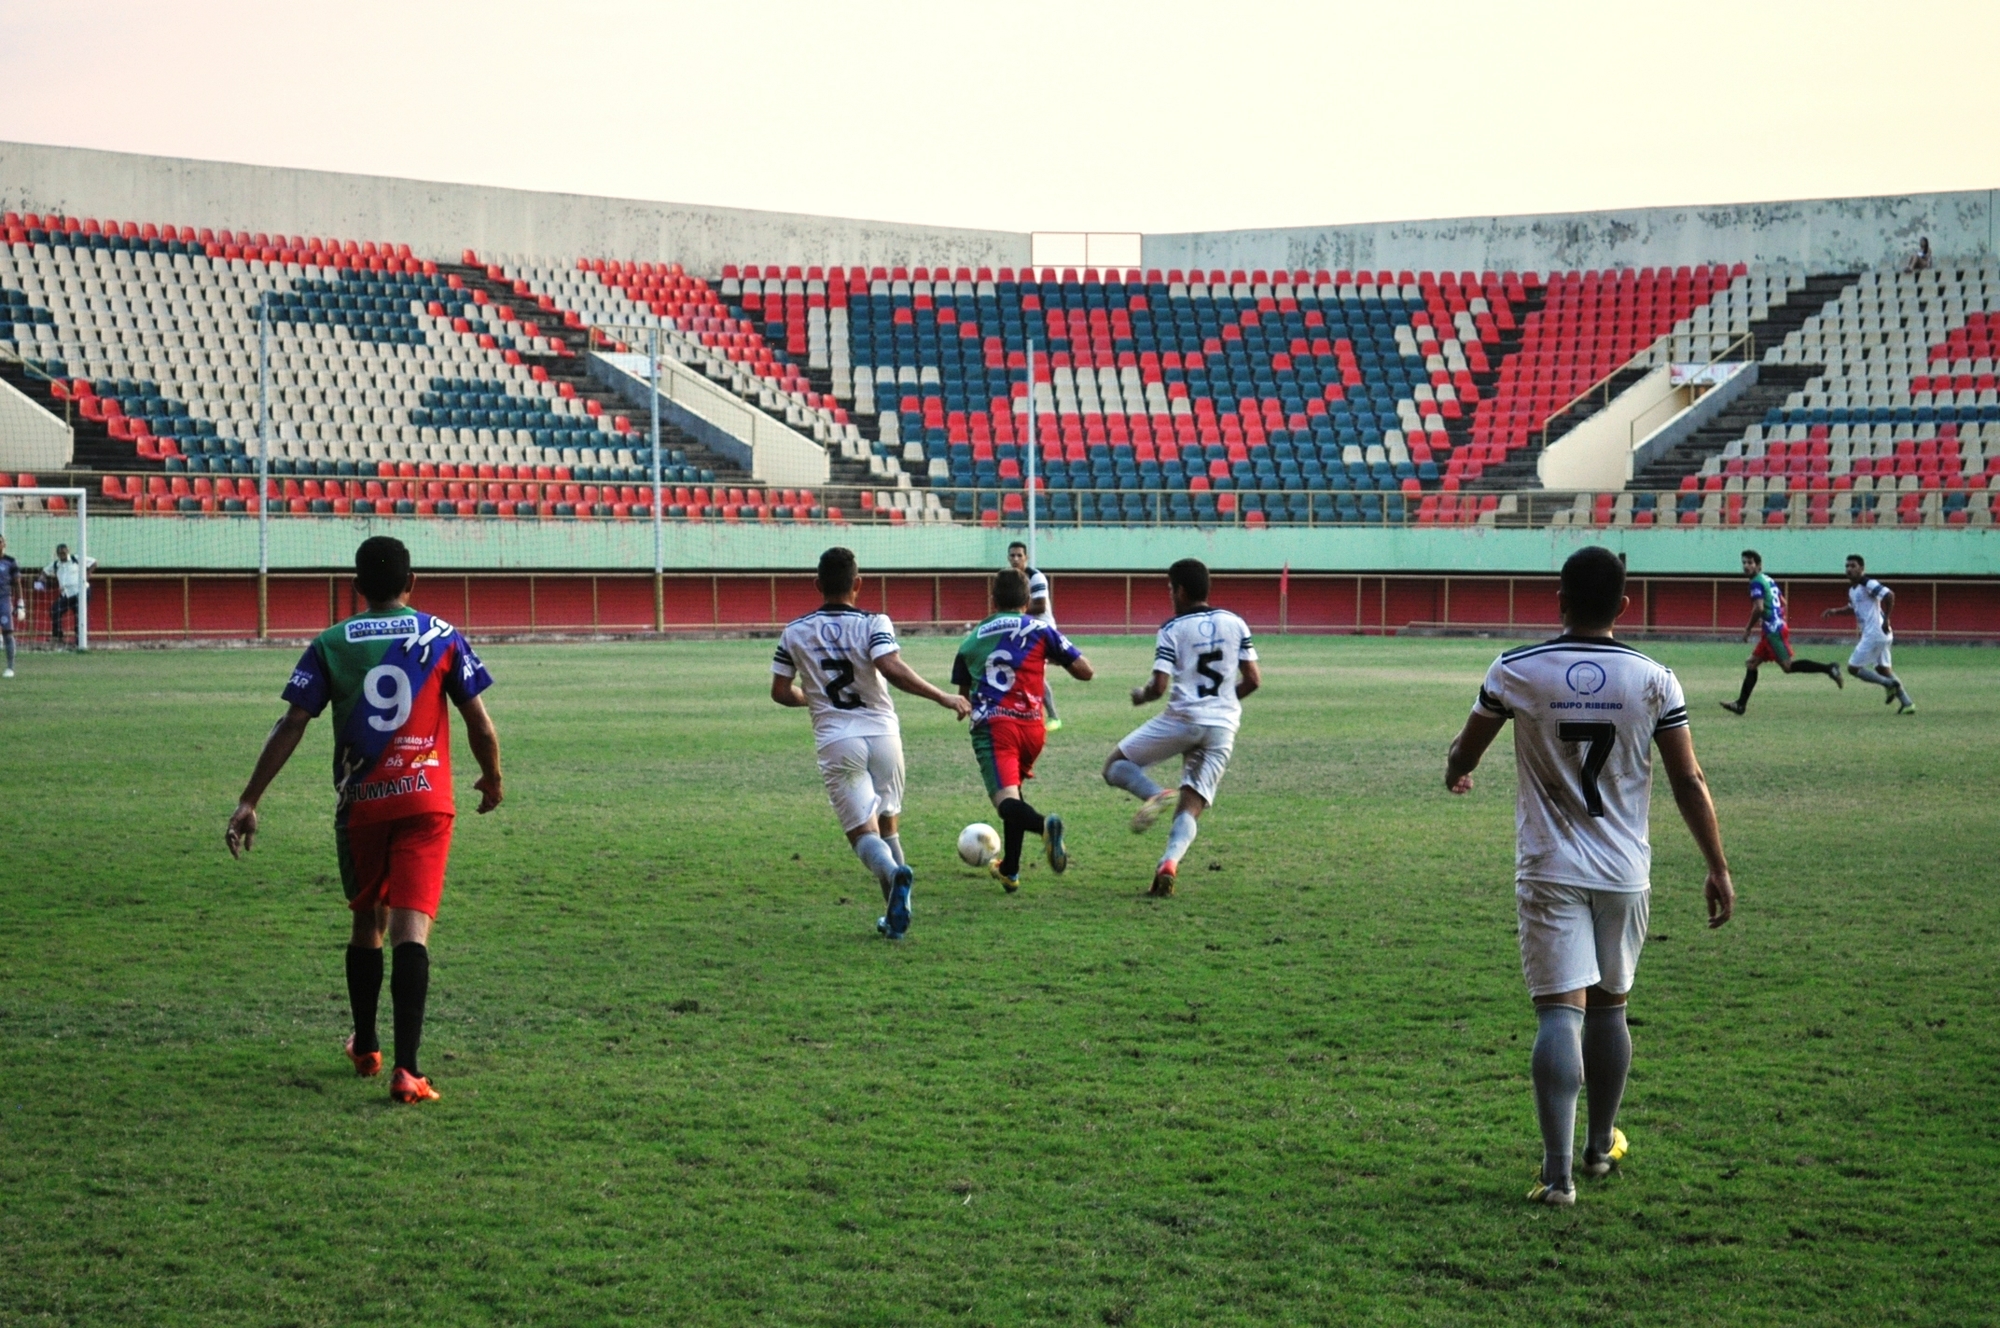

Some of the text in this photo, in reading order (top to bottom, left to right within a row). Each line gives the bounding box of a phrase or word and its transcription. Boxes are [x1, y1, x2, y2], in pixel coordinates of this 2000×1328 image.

[347, 618, 415, 632] PORTO CAR
[820, 658, 867, 710] 2
[985, 649, 1016, 693] 6
[1196, 647, 1224, 698] 5
[363, 664, 412, 732] 9
[1549, 701, 1623, 710] GRUPO RIBEIRO
[1555, 718, 1617, 818] 7
